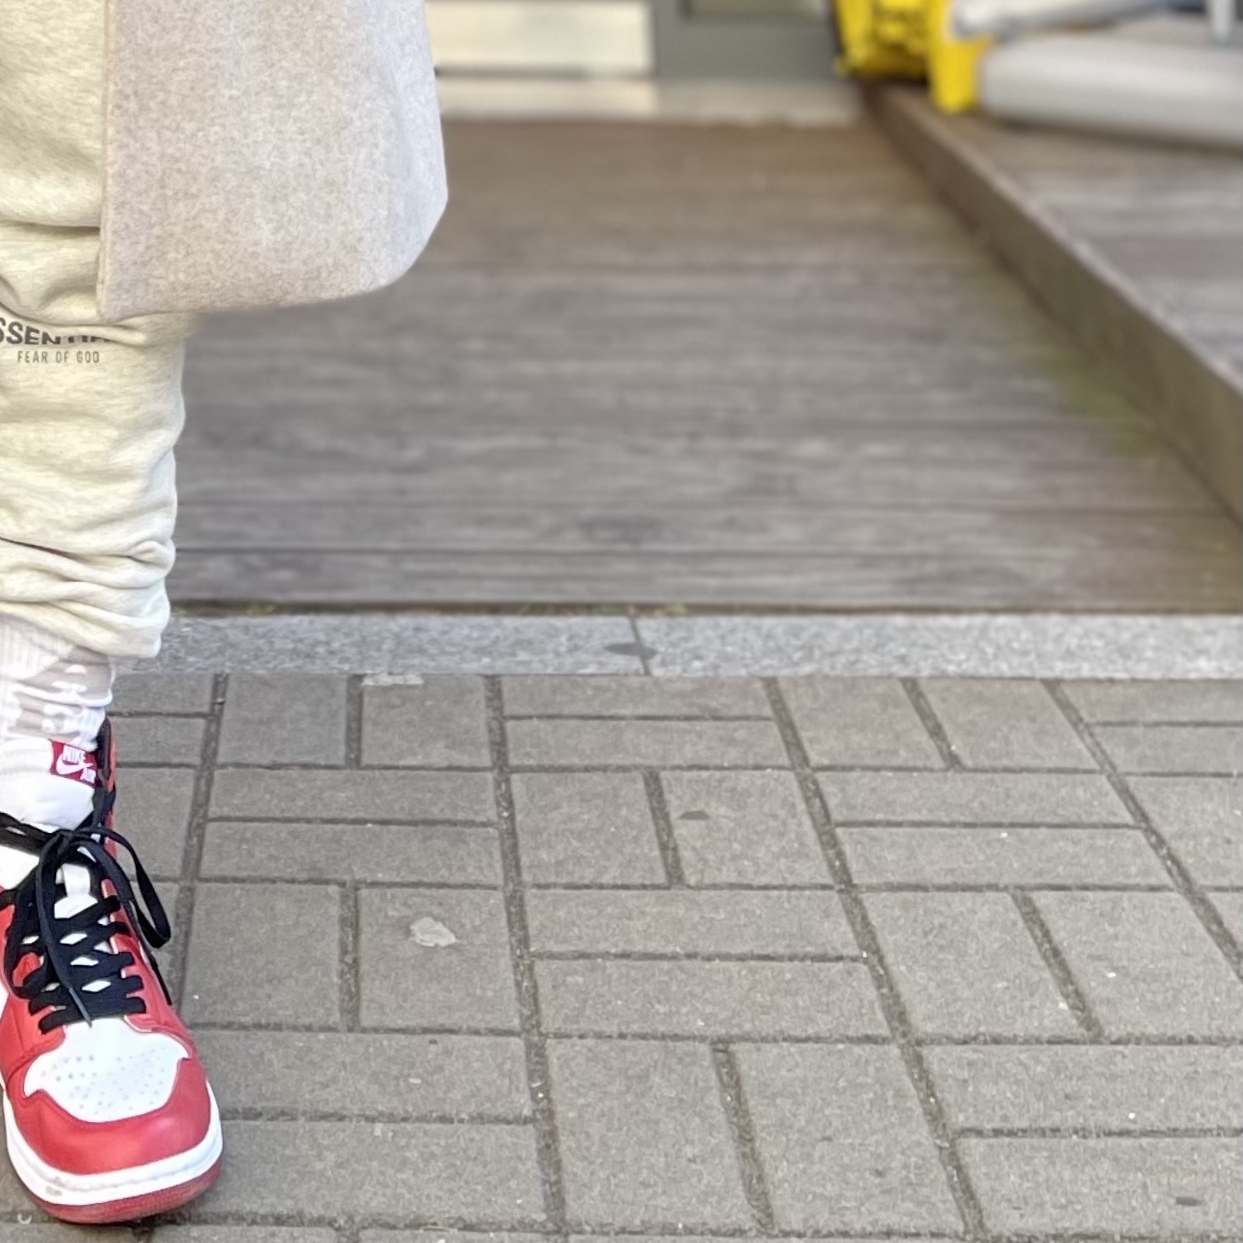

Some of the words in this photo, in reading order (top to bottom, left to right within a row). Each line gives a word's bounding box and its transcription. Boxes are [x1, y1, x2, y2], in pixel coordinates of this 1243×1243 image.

[17, 350, 49, 363] FEAR
[55, 351, 70, 363] OF
[76, 351, 100, 363] GOD
